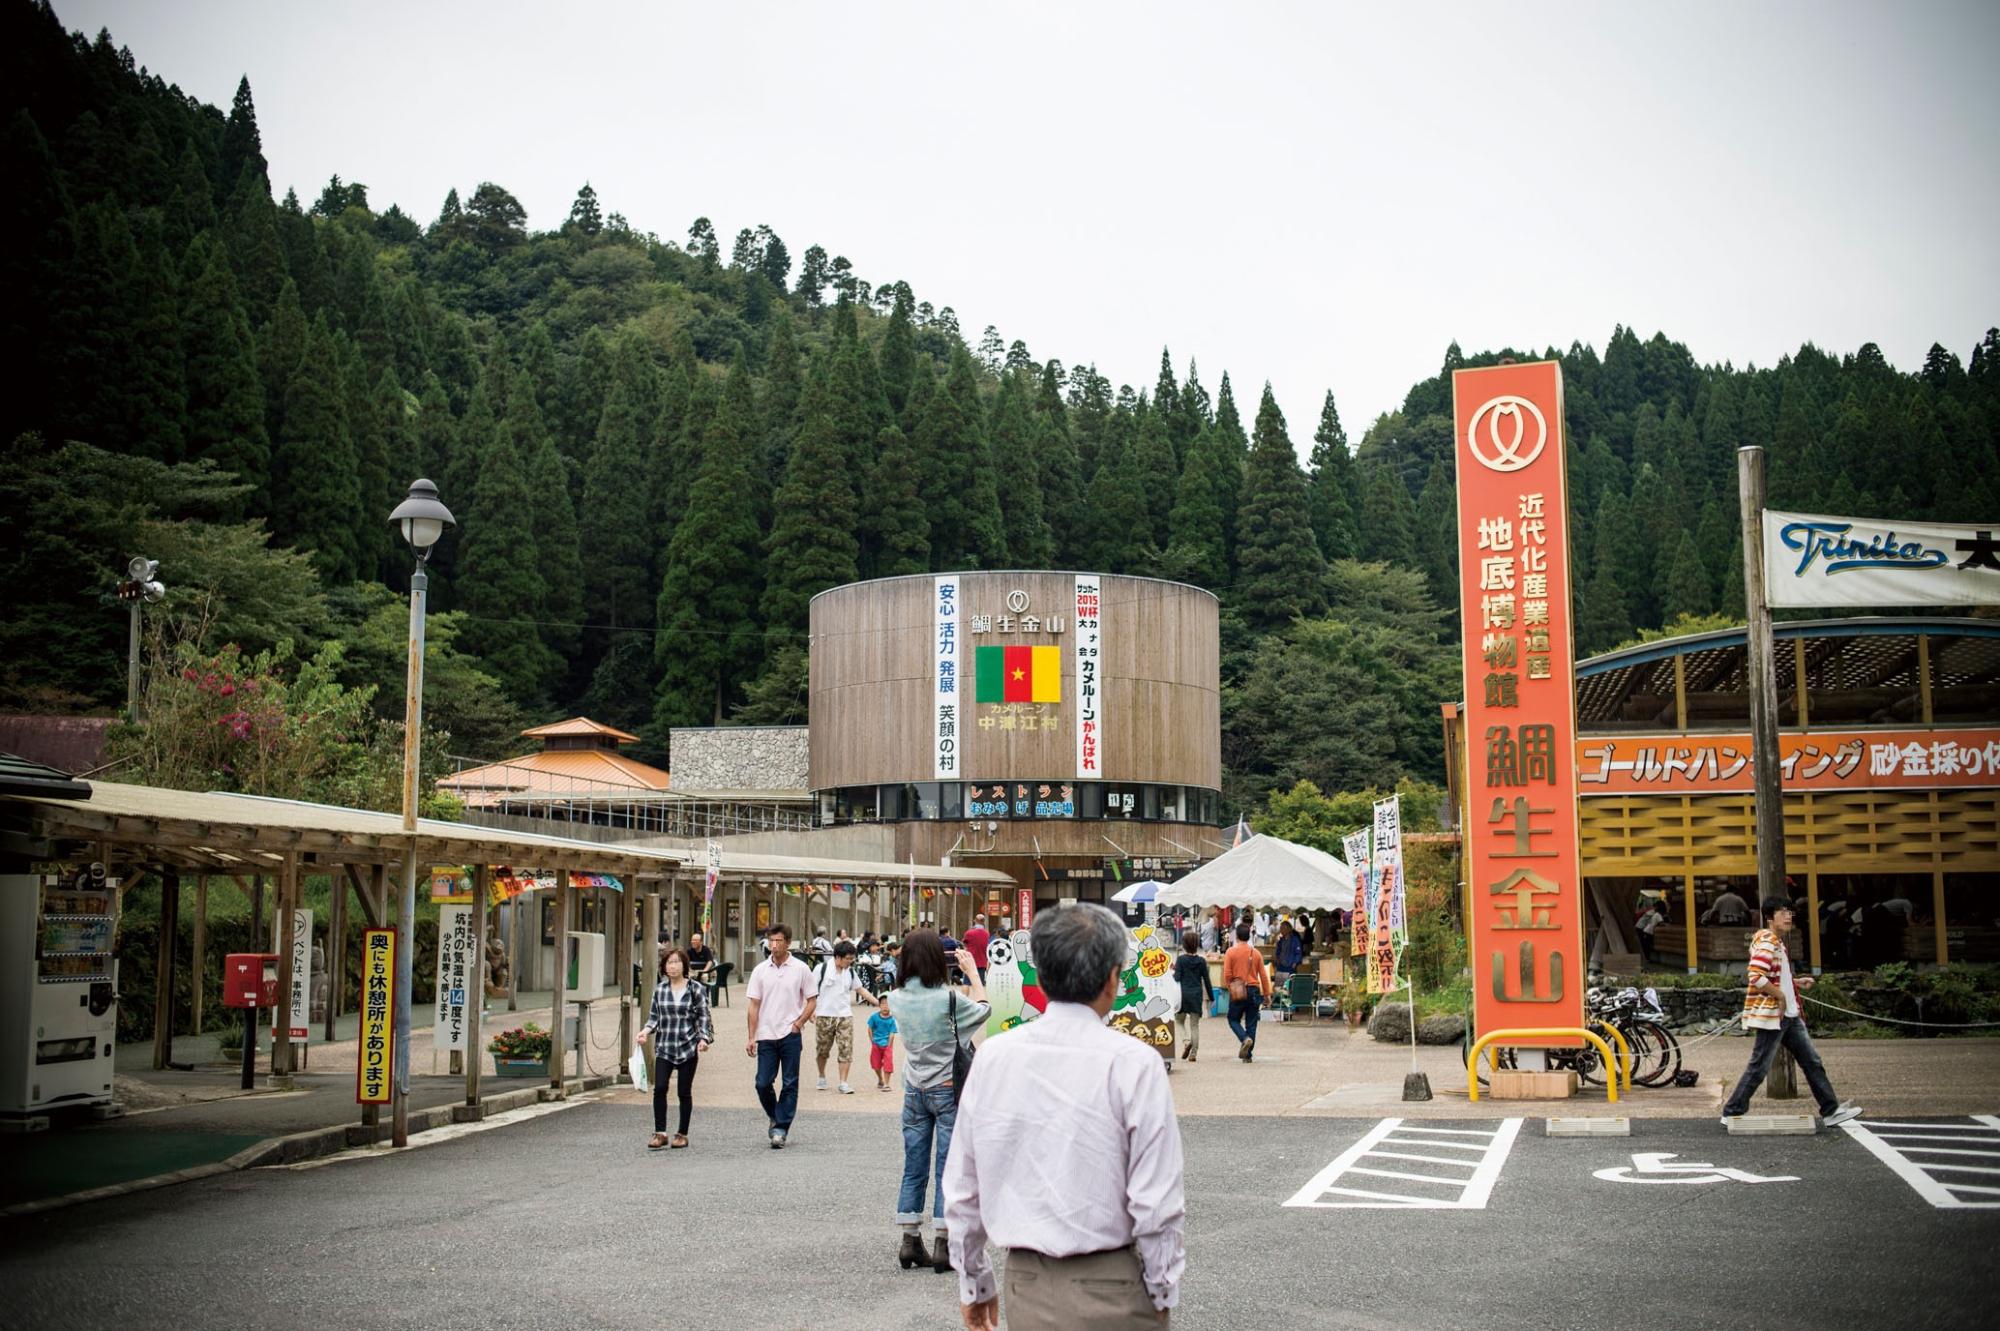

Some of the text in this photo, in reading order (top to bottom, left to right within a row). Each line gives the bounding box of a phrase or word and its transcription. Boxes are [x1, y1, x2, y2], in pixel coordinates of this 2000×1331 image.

[1780, 523, 1949, 578] Trinita
[1077, 585, 1098, 593] サッカー
[1077, 595, 1098, 605] 2015
[1518, 492, 1551, 680] 近代化産業遺産
[971, 615, 1065, 634] 鯛生金山
[1078, 606, 1098, 618] W杯
[1477, 516, 1519, 708] 地底博物館
[1089, 620, 1098, 657] カナダ
[939, 584, 955, 771] 安心 活力 発展 笑顔の村
[991, 704, 1046, 714] カメルーン
[1579, 738, 1865, 784] ゴールドハンィング
[970, 784, 1074, 799] レストラン
[1486, 724, 1565, 1003] 鯛生金山
[440, 932, 451, 1023] 少々肌寒く感じます
[450, 912, 467, 1043] 坑内の気温は14度です
[365, 934, 390, 1098] 奥にも休憩所があります
